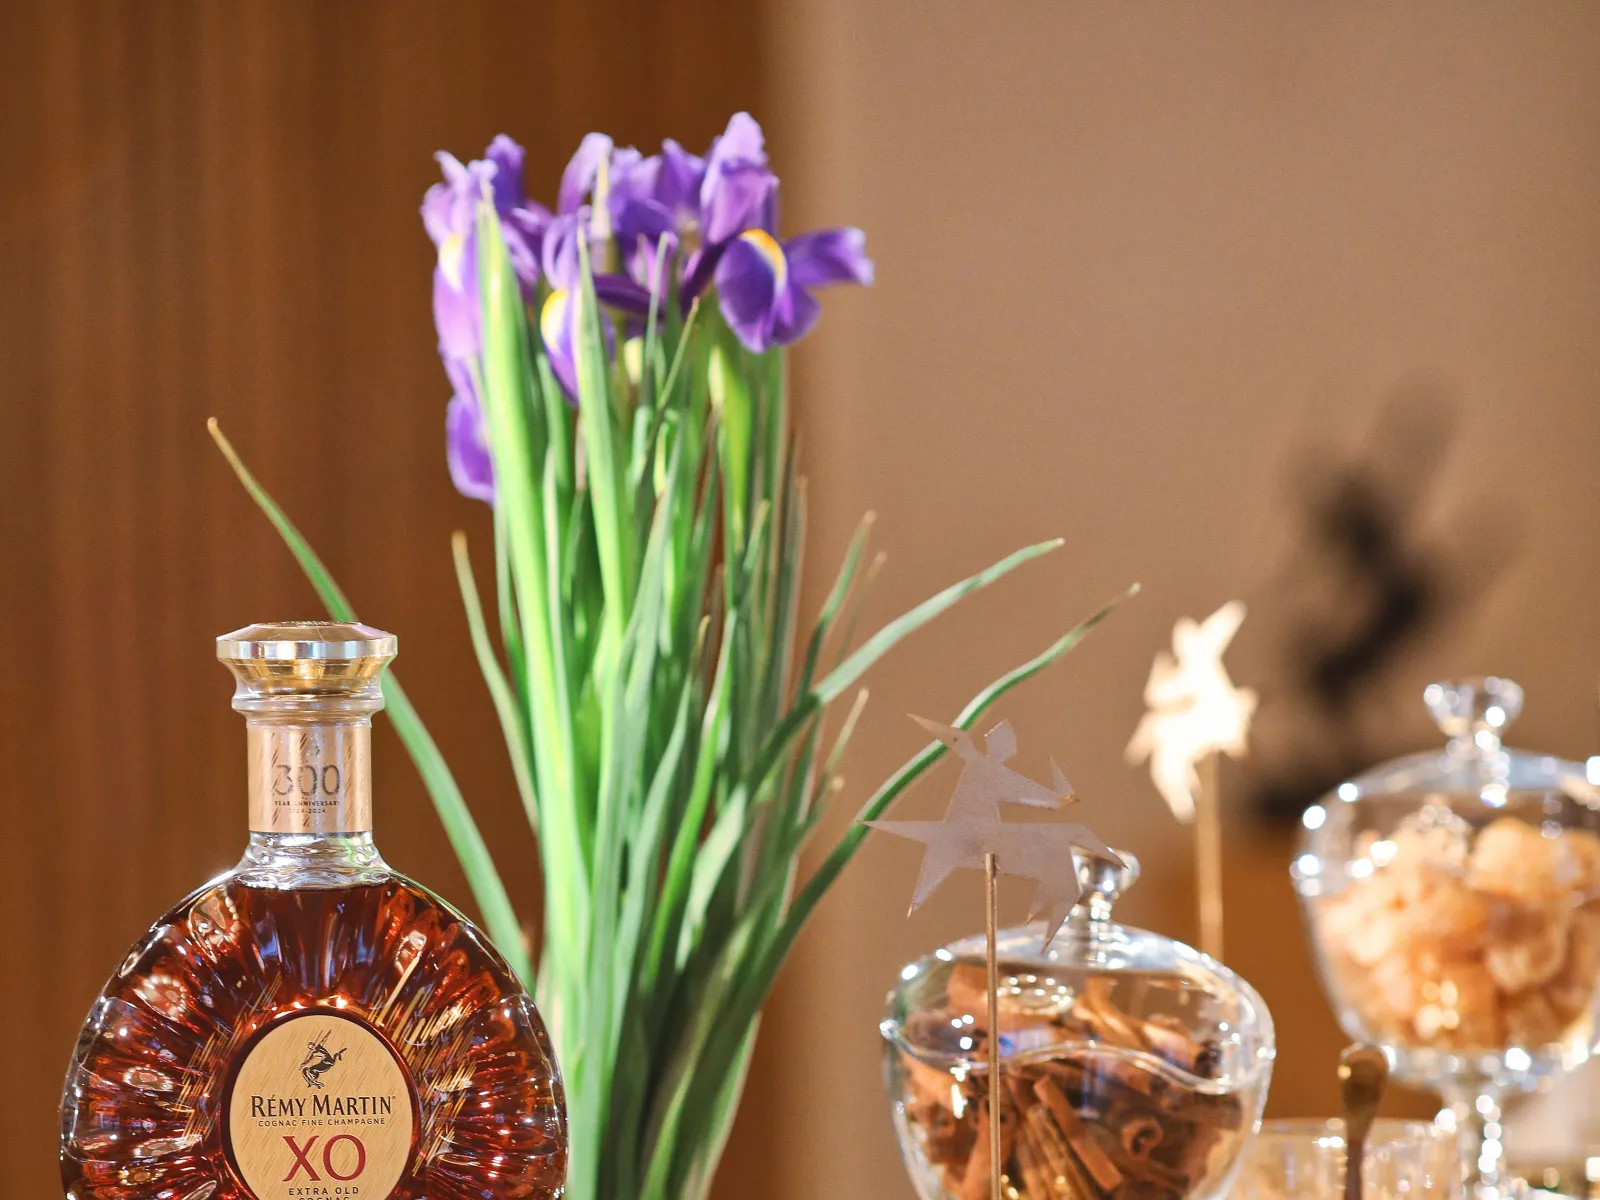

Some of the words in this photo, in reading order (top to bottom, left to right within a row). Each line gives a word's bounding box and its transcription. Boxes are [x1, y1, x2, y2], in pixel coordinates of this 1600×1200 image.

[274, 764, 341, 796] 300
[251, 1094, 306, 1118] RÉMY
[327, 1117, 386, 1126] CHAMPAGNE
[282, 1134, 366, 1182] XO
[288, 1187, 329, 1196] EXTRA
[335, 1186, 359, 1195] OLD
